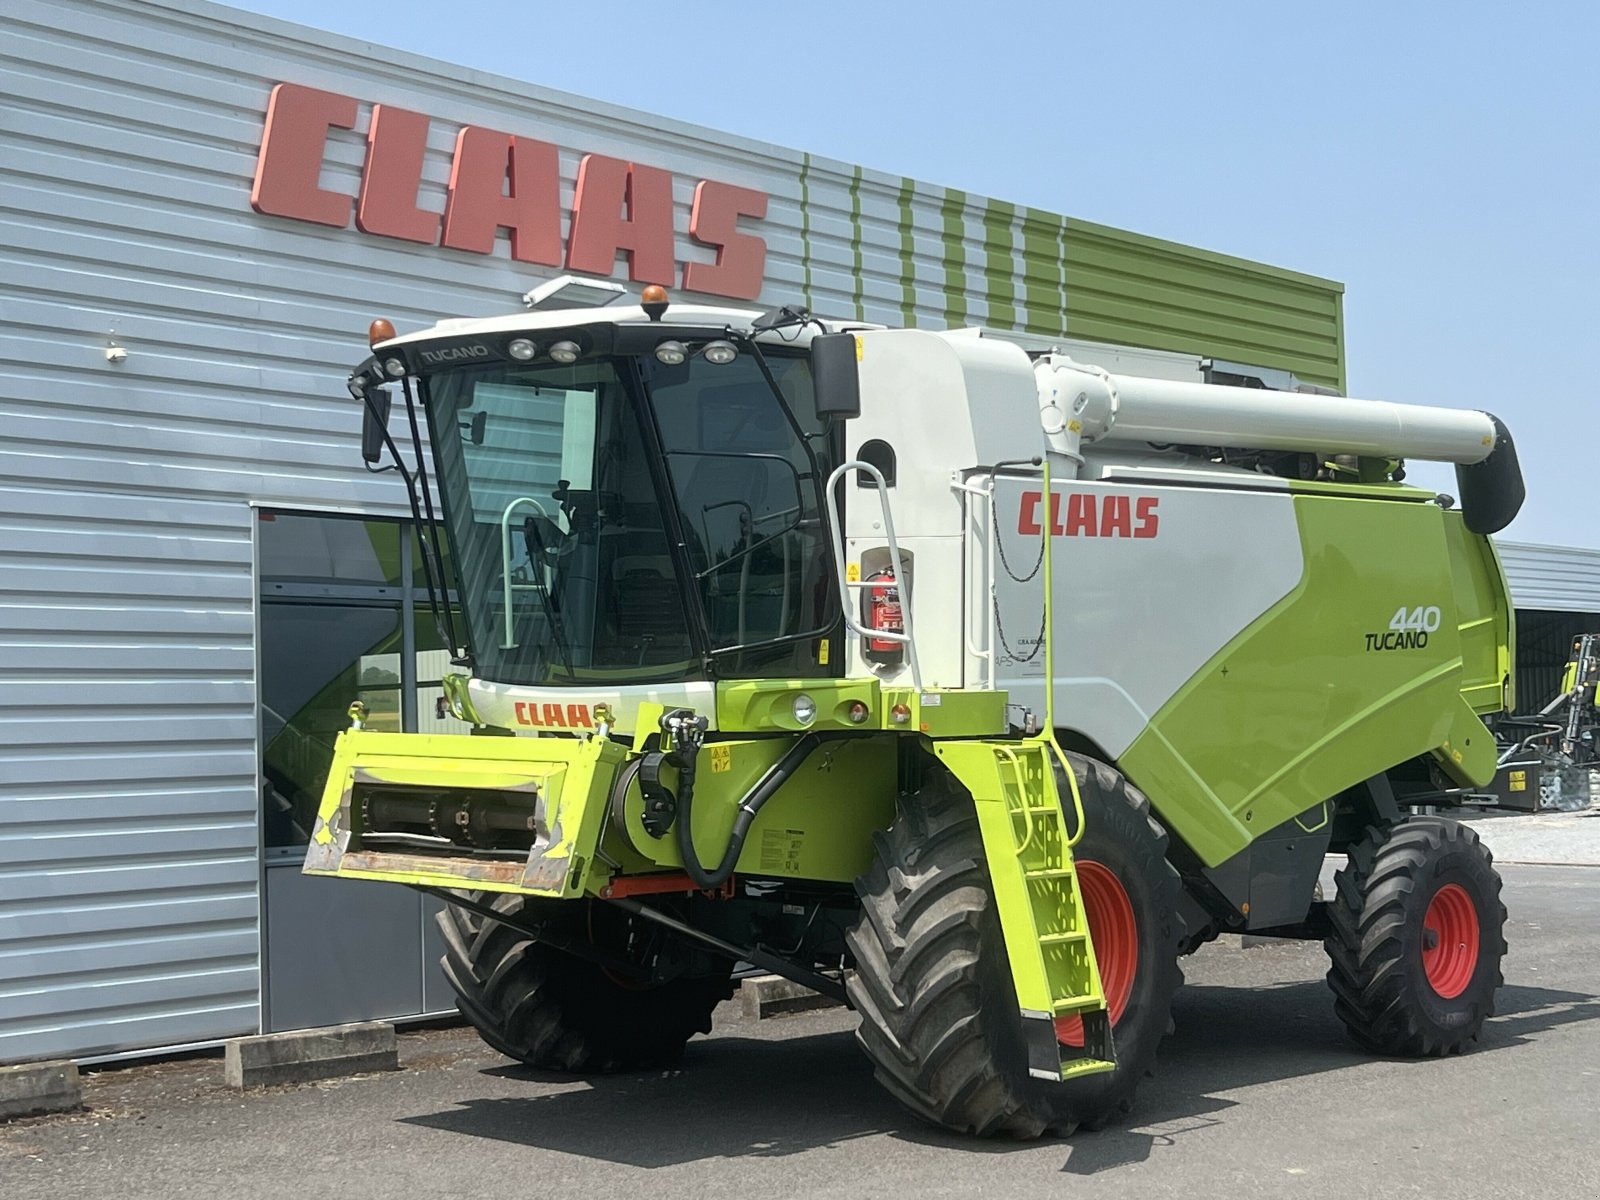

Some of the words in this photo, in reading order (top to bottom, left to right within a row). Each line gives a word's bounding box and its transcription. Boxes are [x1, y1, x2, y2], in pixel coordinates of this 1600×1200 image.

[250, 83, 768, 301] CLAAS
[421, 345, 489, 362] TUCANO
[1018, 491, 1159, 538] CLAAS
[1389, 606, 1441, 632] 440
[1365, 631, 1428, 652] TUCANO
[515, 702, 614, 728] CLAA
